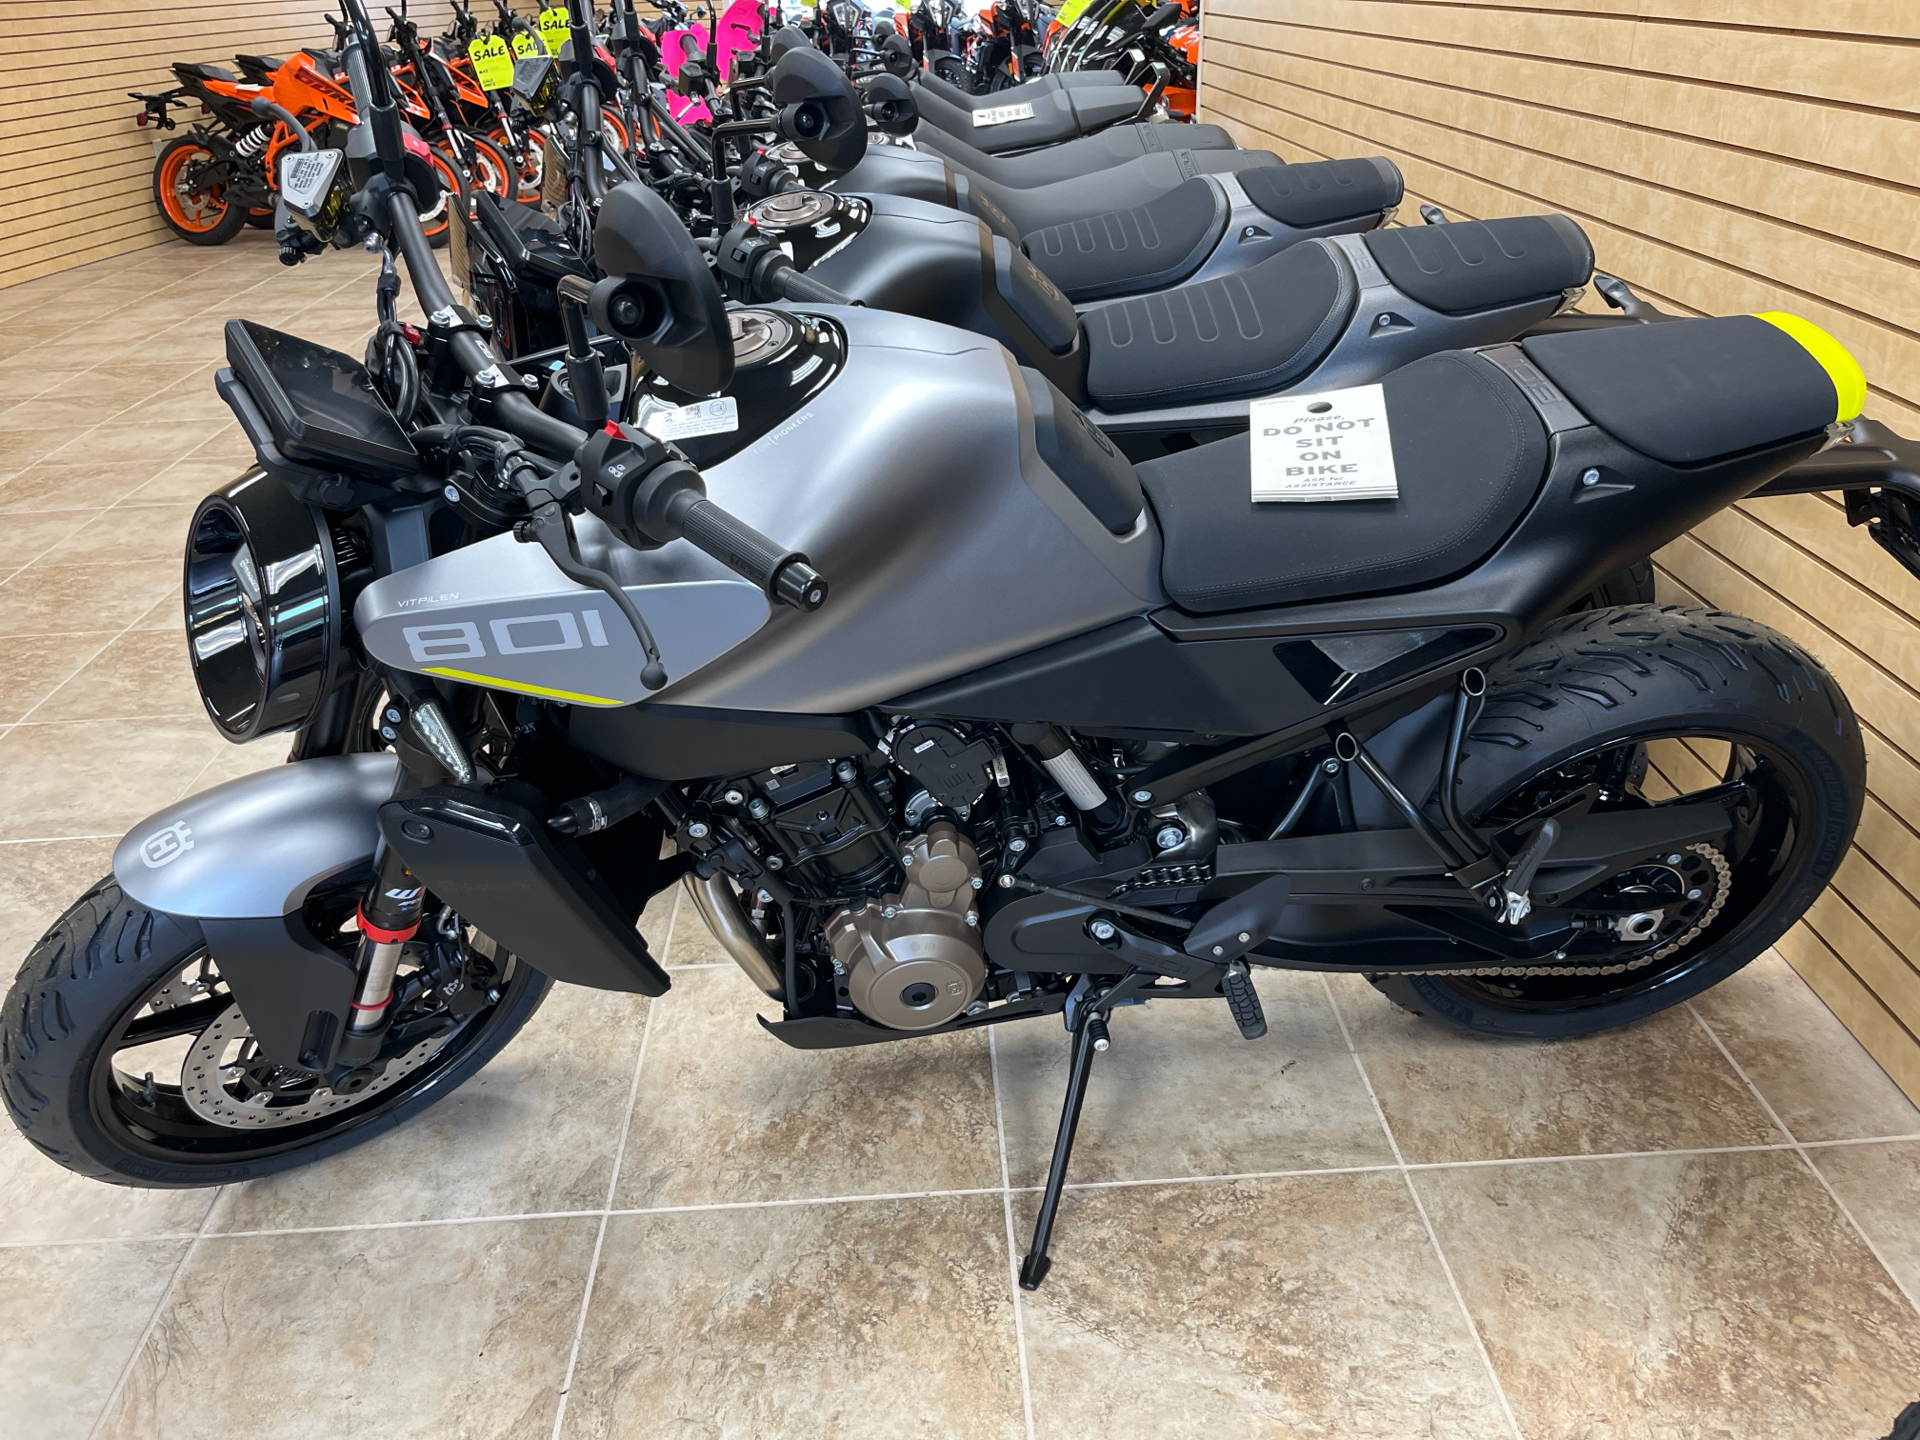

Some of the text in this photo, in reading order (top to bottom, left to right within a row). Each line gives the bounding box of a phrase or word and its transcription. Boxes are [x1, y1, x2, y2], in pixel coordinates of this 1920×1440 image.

[543, 19, 570, 31] SALE
[474, 45, 506, 62] SALE
[773, 411, 814, 441] PIONEERS
[1263, 417, 1375, 436] DO NOT
[1295, 435, 1344, 448] SIT
[1299, 450, 1342, 461] ON
[1285, 463, 1359, 476] BIKE
[1285, 480, 1357, 488] ASSISTANCE
[398, 592, 460, 608] VITPILEN
[402, 609, 609, 663] 801
